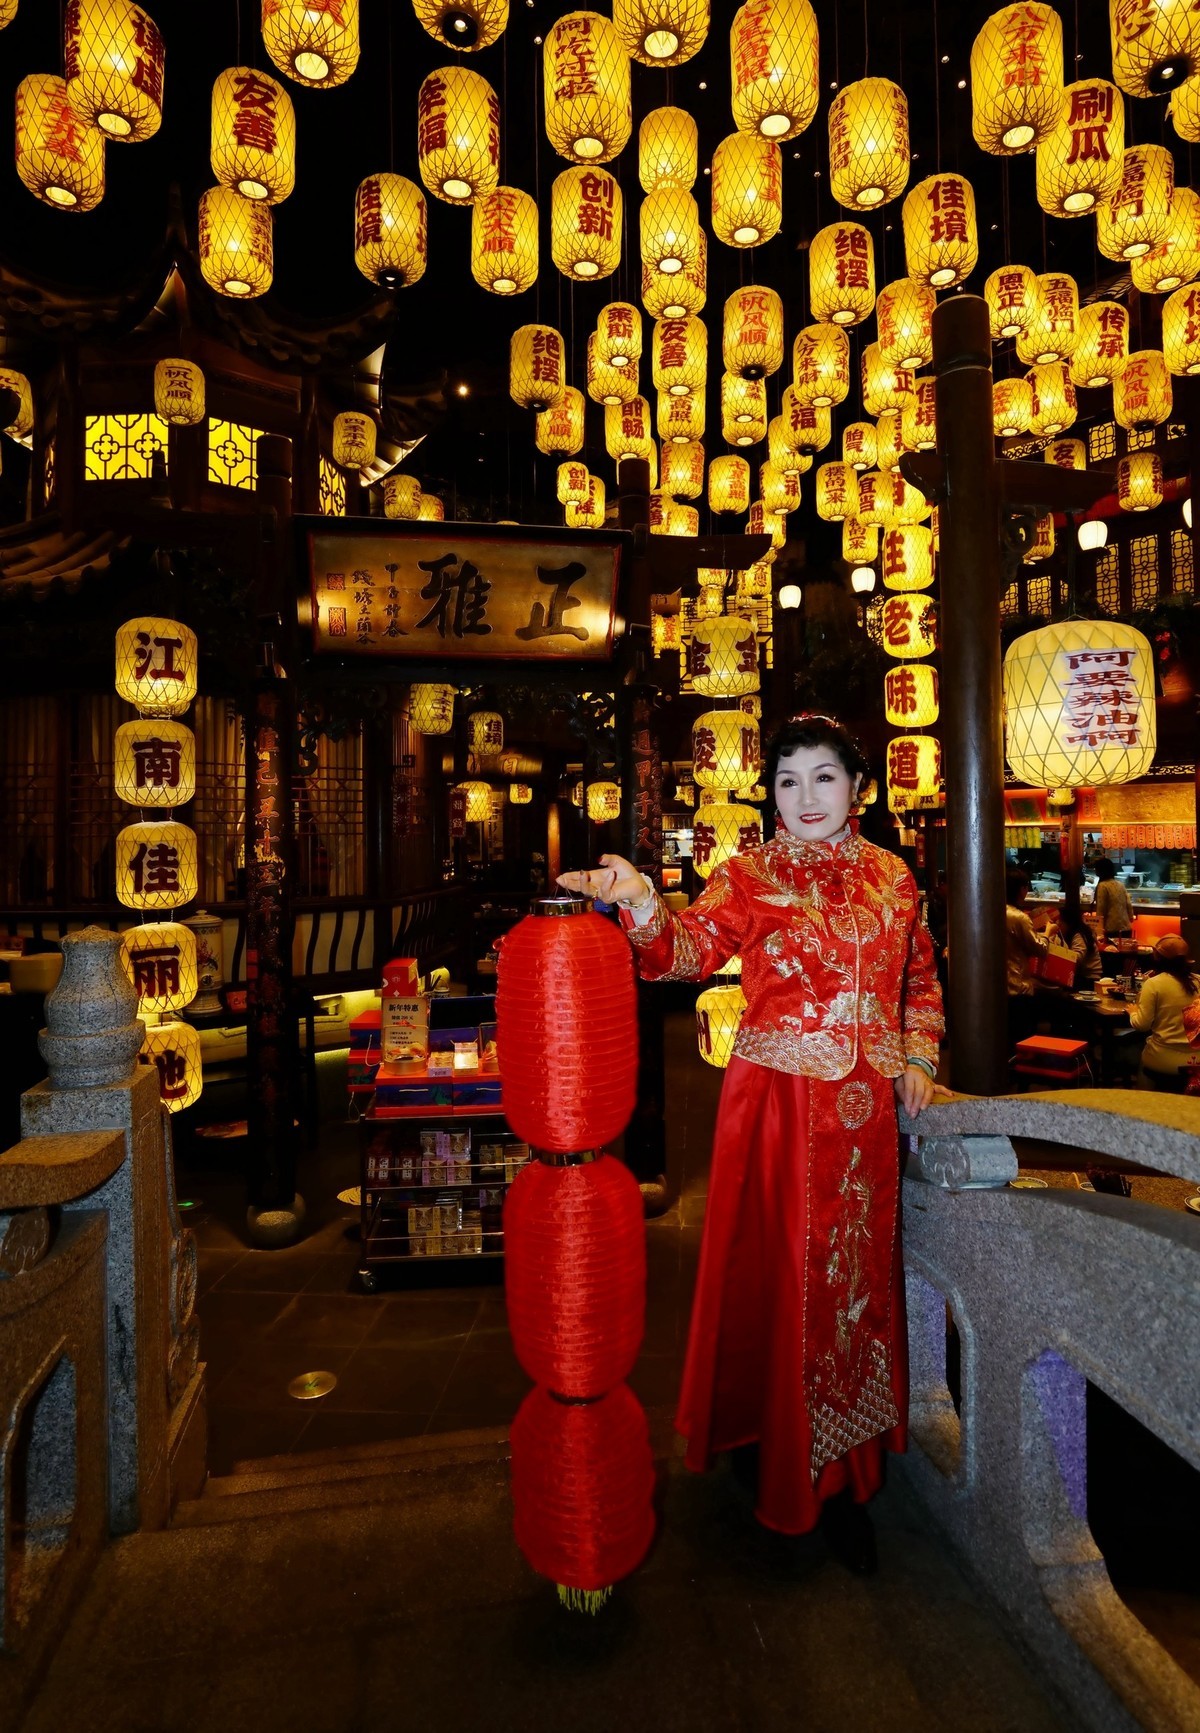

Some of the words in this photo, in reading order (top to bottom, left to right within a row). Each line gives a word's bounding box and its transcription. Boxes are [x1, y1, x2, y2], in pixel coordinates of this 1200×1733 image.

[555, 17, 598, 101] 阿吃过啦
[1004, 6, 1047, 88] 八方来财
[234, 74, 278, 154] 友善
[419, 77, 447, 158] 幸福
[1066, 86, 1113, 166] 刷瓜
[356, 180, 382, 250] 佳境
[482, 191, 517, 254] 六六大顺
[578, 172, 614, 241] 创新
[928, 180, 968, 243] 佳境
[835, 229, 869, 290] 绝摆
[738, 290, 769, 345] 一帆风顺
[997, 273, 1024, 311] 恩正
[1044, 278, 1074, 333] 五福临门
[532, 329, 560, 386] 绝摆
[660, 321, 688, 369] 友善
[798, 333, 820, 386] 八方来财
[1098, 307, 1126, 359] 传承
[164, 366, 193, 400] 一帆风顺
[669, 395, 693, 423] 高照
[893, 370, 913, 394] 正
[1122, 358, 1150, 411] 一帆风顺
[343, 417, 364, 448] 四季平安
[845, 429, 865, 453] 胎气
[568, 467, 586, 492] 创新
[822, 465, 848, 504] 摆的一来
[857, 476, 877, 512] 宜当
[1064, 650, 1141, 747] 阿要辣油啊
[485, 719, 502, 745] 佳境
